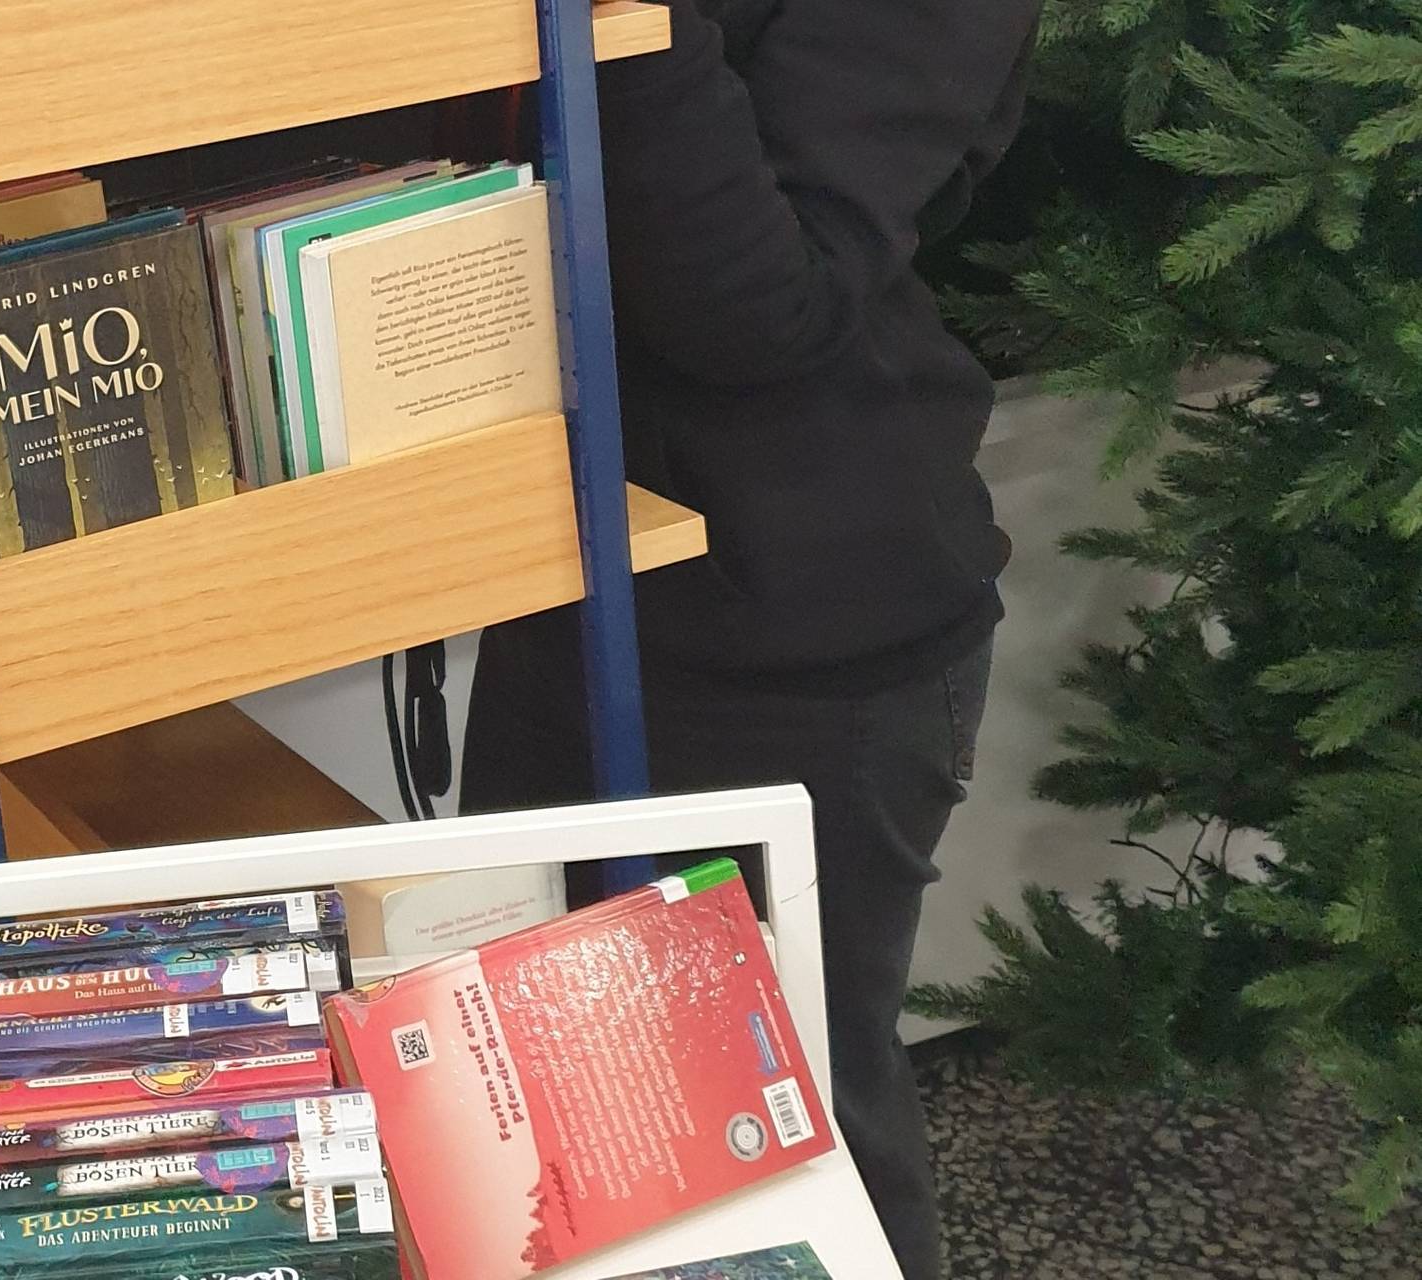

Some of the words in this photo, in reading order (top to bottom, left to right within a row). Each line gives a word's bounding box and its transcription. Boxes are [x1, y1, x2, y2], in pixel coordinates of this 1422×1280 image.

[50, 262, 158, 299] LINDGREN
[91, 362, 164, 402] MIO
[19, 448, 63, 468] JOHAN
[67, 426, 145, 455] EGERKRANS
[23, 421, 111, 452] ILLUSTRATIONEN
[114, 416, 135, 431] VON
[162, 914, 194, 928] liegt
[198, 914, 212, 922] in
[247, 906, 281, 917] Luft
[75, 989, 96, 999] Das
[98, 985, 126, 998] Haus
[128, 984, 146, 996] auf
[34, 1023, 73, 1034] GEHEIME
[76, 1017, 126, 1030] NACHTPOST
[453, 990, 476, 1038] einer
[466, 983, 524, 1123] Pferde-Ranch!
[469, 1045, 489, 1076] auf
[74, 1122, 140, 1139] BÖSEN
[146, 1115, 208, 1135] TIERE
[486, 1080, 512, 1141] Ferien
[76, 1166, 143, 1183] BÖSEN
[151, 1161, 197, 1178] TIER
[18, 1194, 259, 1238] FLUSTERWALD
[38, 1232, 65, 1248] DAS
[71, 1224, 159, 1245] ABENTEUER
[165, 1217, 232, 1235] BEGINNT
